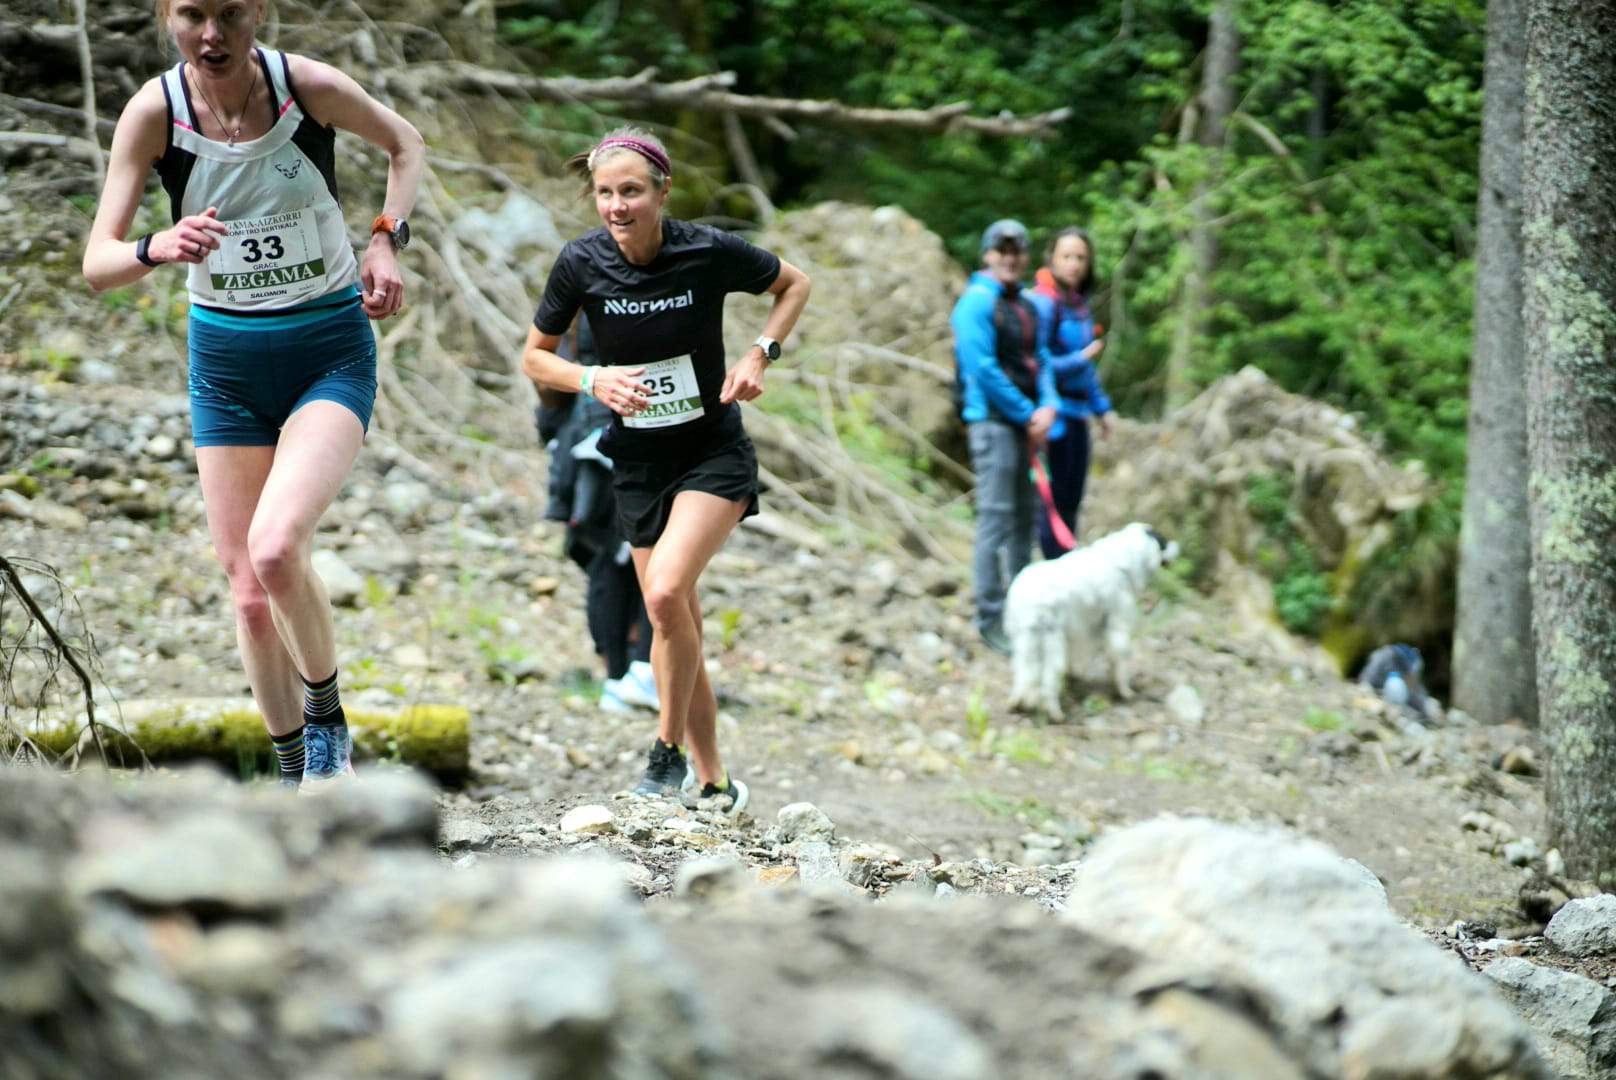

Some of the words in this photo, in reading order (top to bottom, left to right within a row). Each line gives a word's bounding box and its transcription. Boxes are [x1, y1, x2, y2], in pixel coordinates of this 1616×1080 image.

[226, 211, 302, 230] GAMA-AIZKORRI
[228, 227, 260, 237] OMETRO
[261, 221, 298, 233] BERTIKALA
[241, 235, 285, 263] 33
[253, 263, 279, 271] GRACE
[223, 264, 315, 289] ZEGAMA
[251, 290, 288, 299] SALOMON
[634, 376, 676, 397] 25
[634, 399, 693, 417] EGAMA
